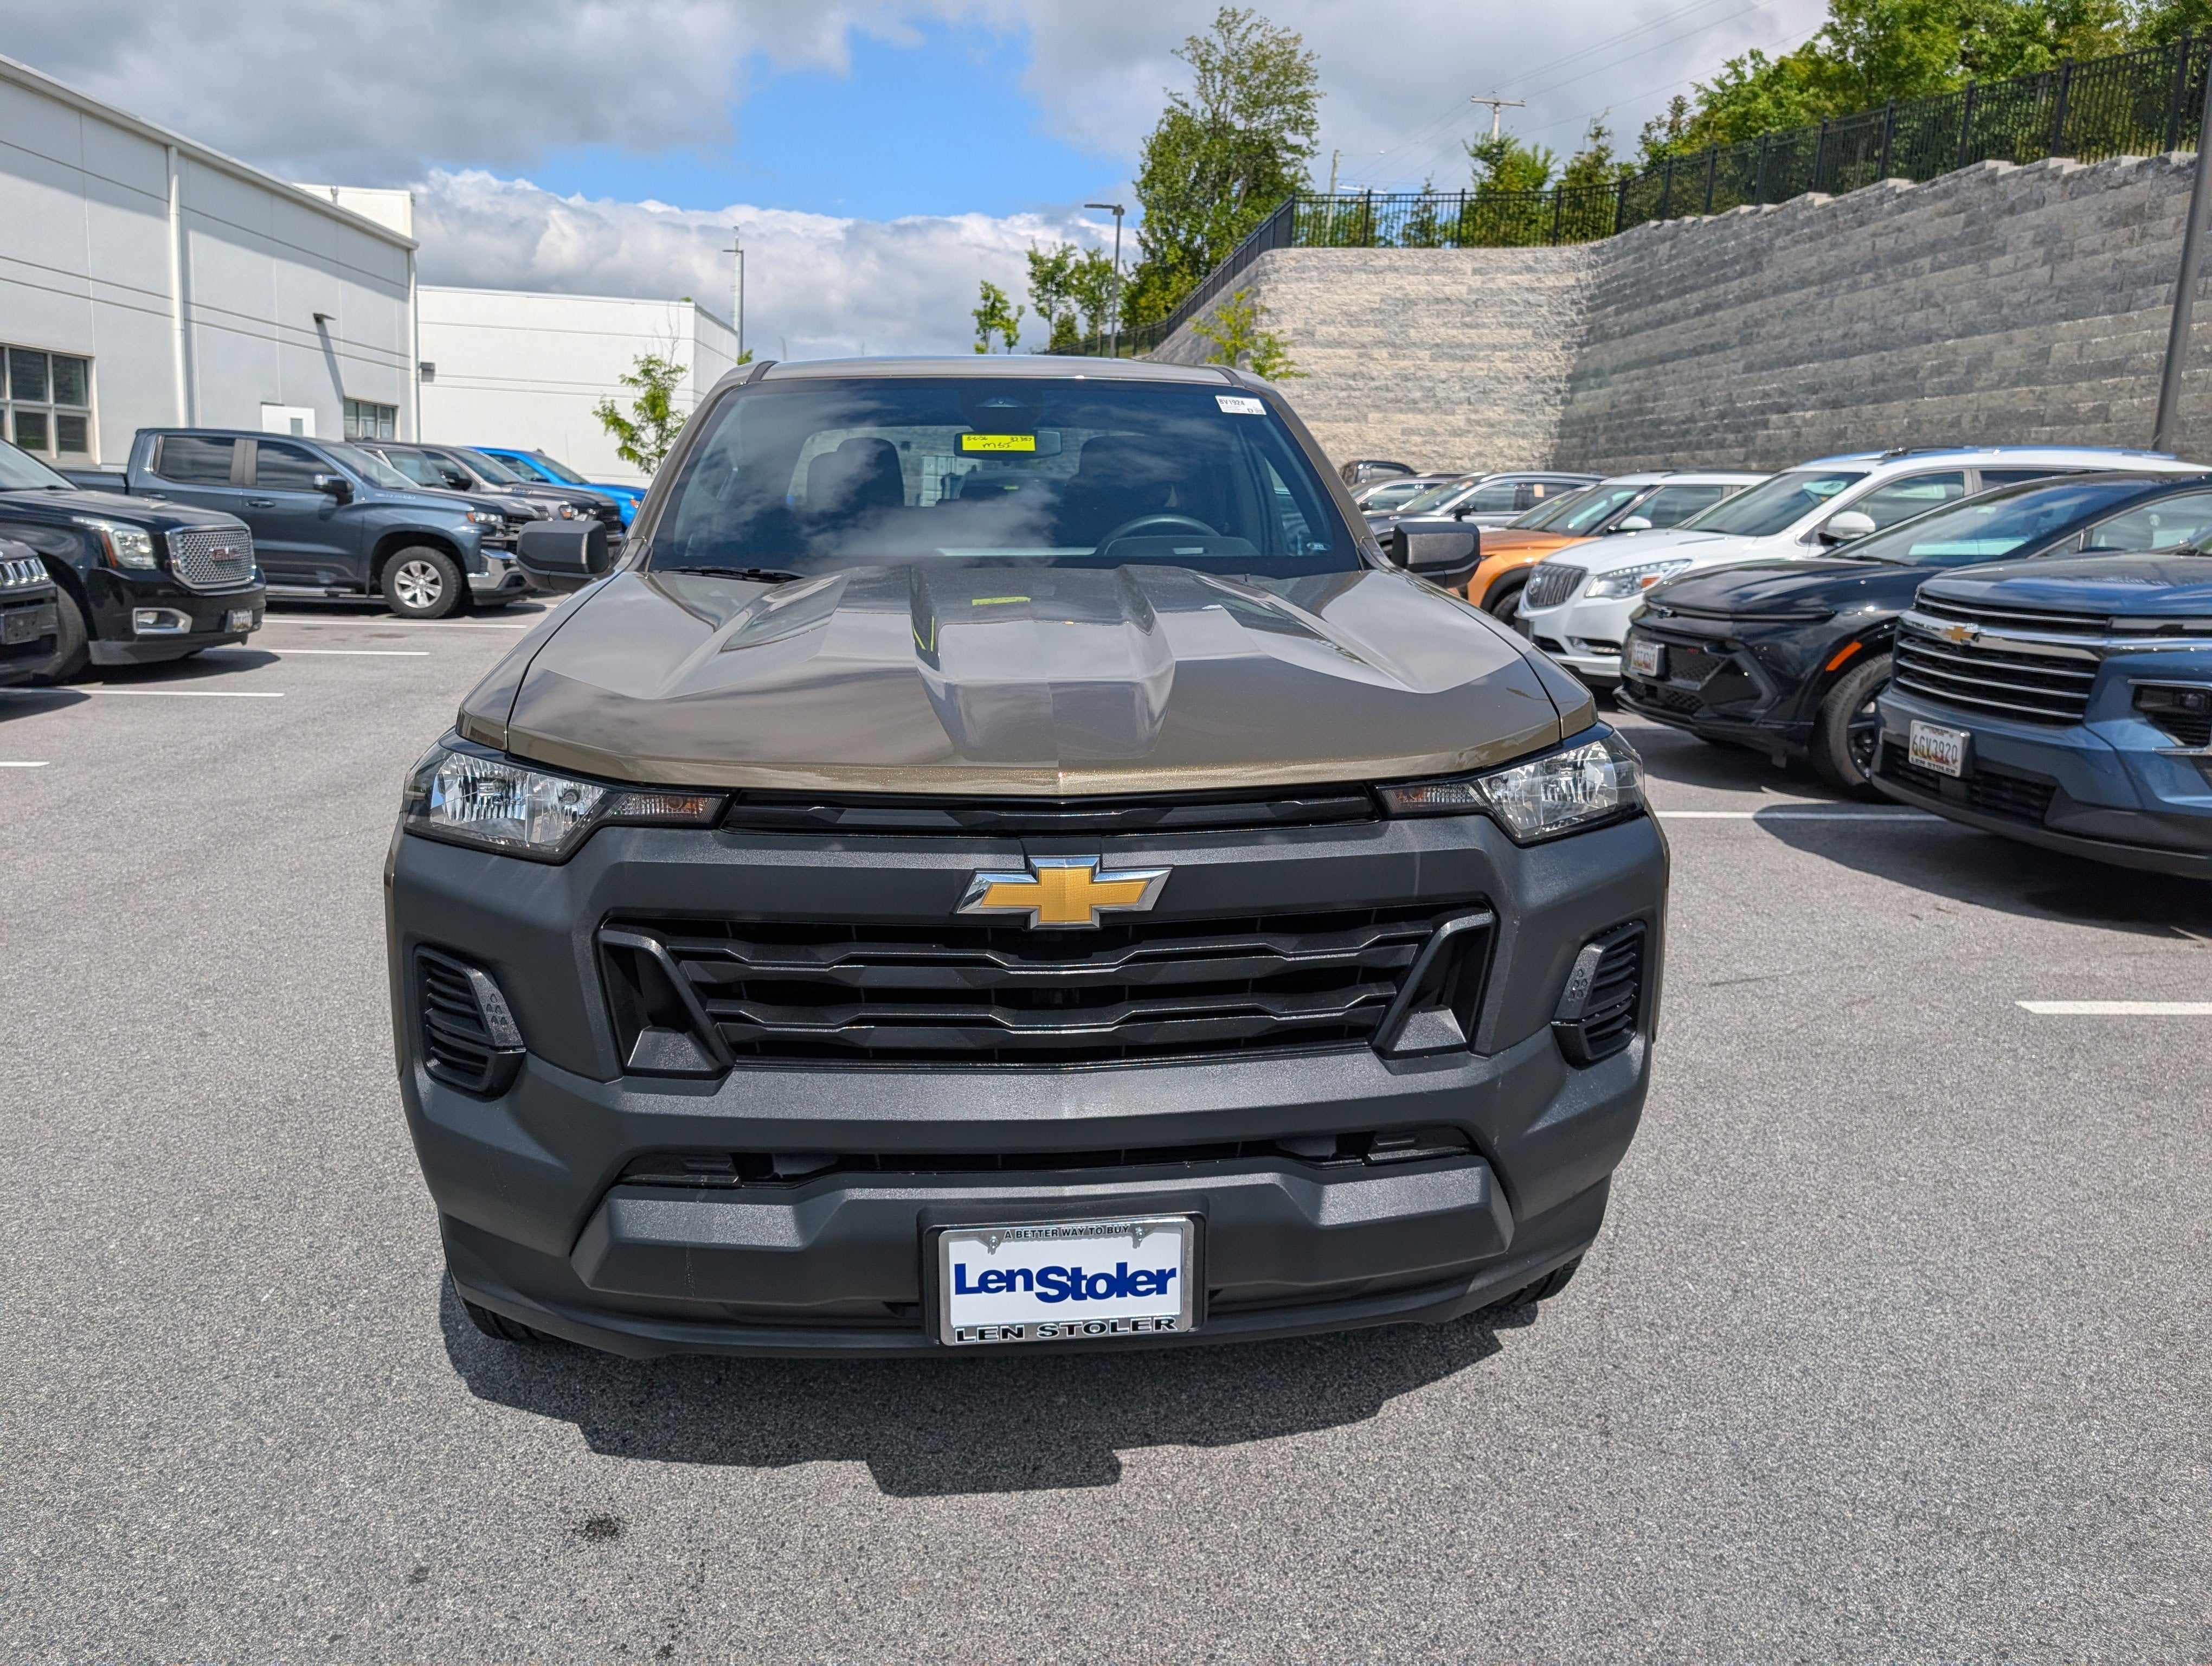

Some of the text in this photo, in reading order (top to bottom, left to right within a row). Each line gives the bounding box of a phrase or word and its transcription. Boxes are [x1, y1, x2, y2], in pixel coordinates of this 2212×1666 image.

[1004, 1225, 1130, 1239] A BETTER WAY TO BUY
[954, 1261, 1177, 1304] LenStoler
[955, 1317, 1179, 1343] LEN STOLER
